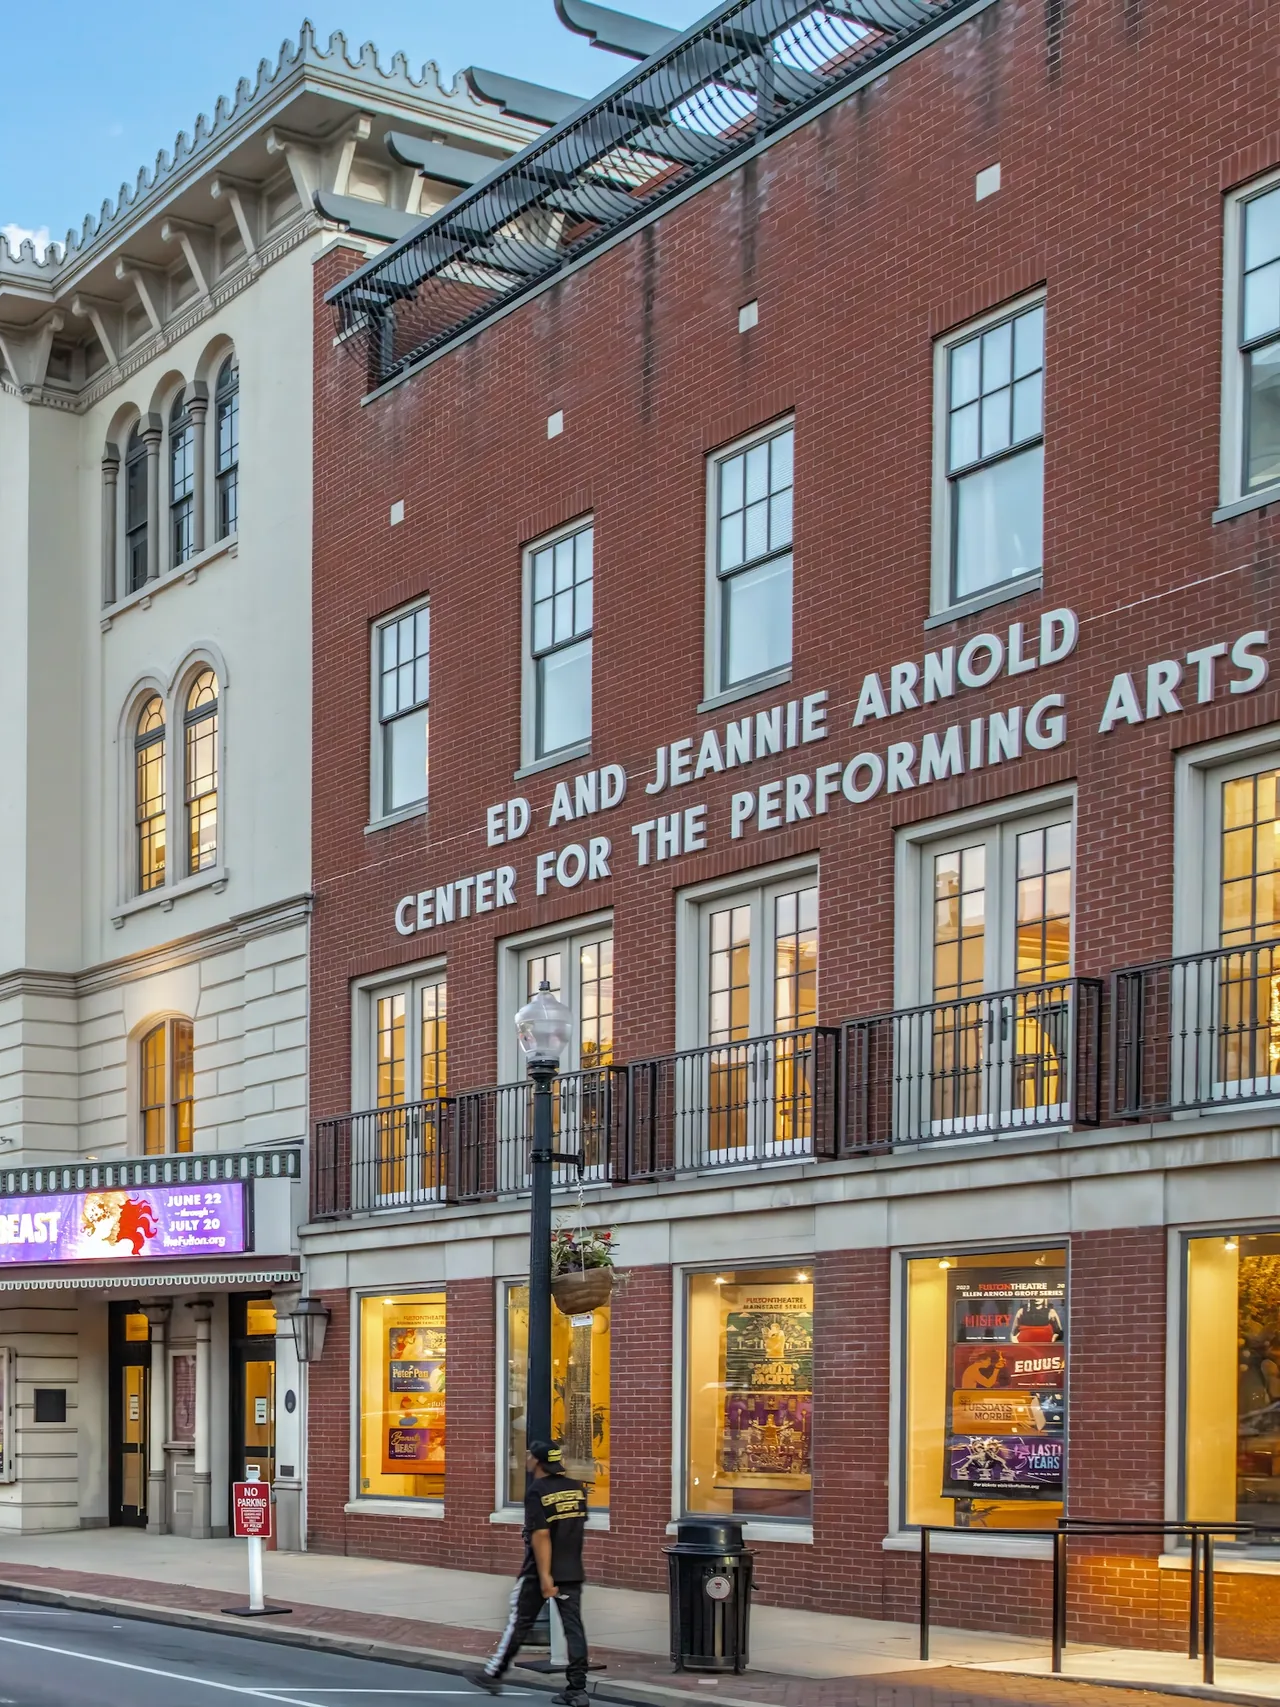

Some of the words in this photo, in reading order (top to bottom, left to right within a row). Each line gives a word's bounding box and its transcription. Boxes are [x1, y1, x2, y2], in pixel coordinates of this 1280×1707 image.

[486, 797, 531, 847] ED
[548, 764, 627, 827] AND
[644, 690, 830, 795] JEANNIE
[852, 608, 1079, 727] ARNOLD
[394, 865, 517, 936] CENTER
[536, 836, 612, 896] FOR
[631, 804, 708, 866] THE
[731, 693, 1067, 840] PERFORMING
[1098, 630, 1269, 734] ARTS
[167, 1194, 202, 1207] JUNE
[204, 1193, 222, 1205] 22
[168, 1220, 200, 1232] JULY
[203, 1218, 221, 1230] 20
[965, 1314, 1011, 1327] MISERY
[1014, 1356, 1061, 1373] EQUUS
[392, 1367, 413, 1378] Peter
[414, 1368, 429, 1378] Pan
[751, 1374, 795, 1384] PACIFIC
[961, 1402, 1012, 1412] TUESDAYS
[974, 1412, 1012, 1421] MORRIE
[1028, 1456, 1060, 1469] YEARS
[244, 1487, 258, 1496] NO
[237, 1498, 267, 1507] PARKING
